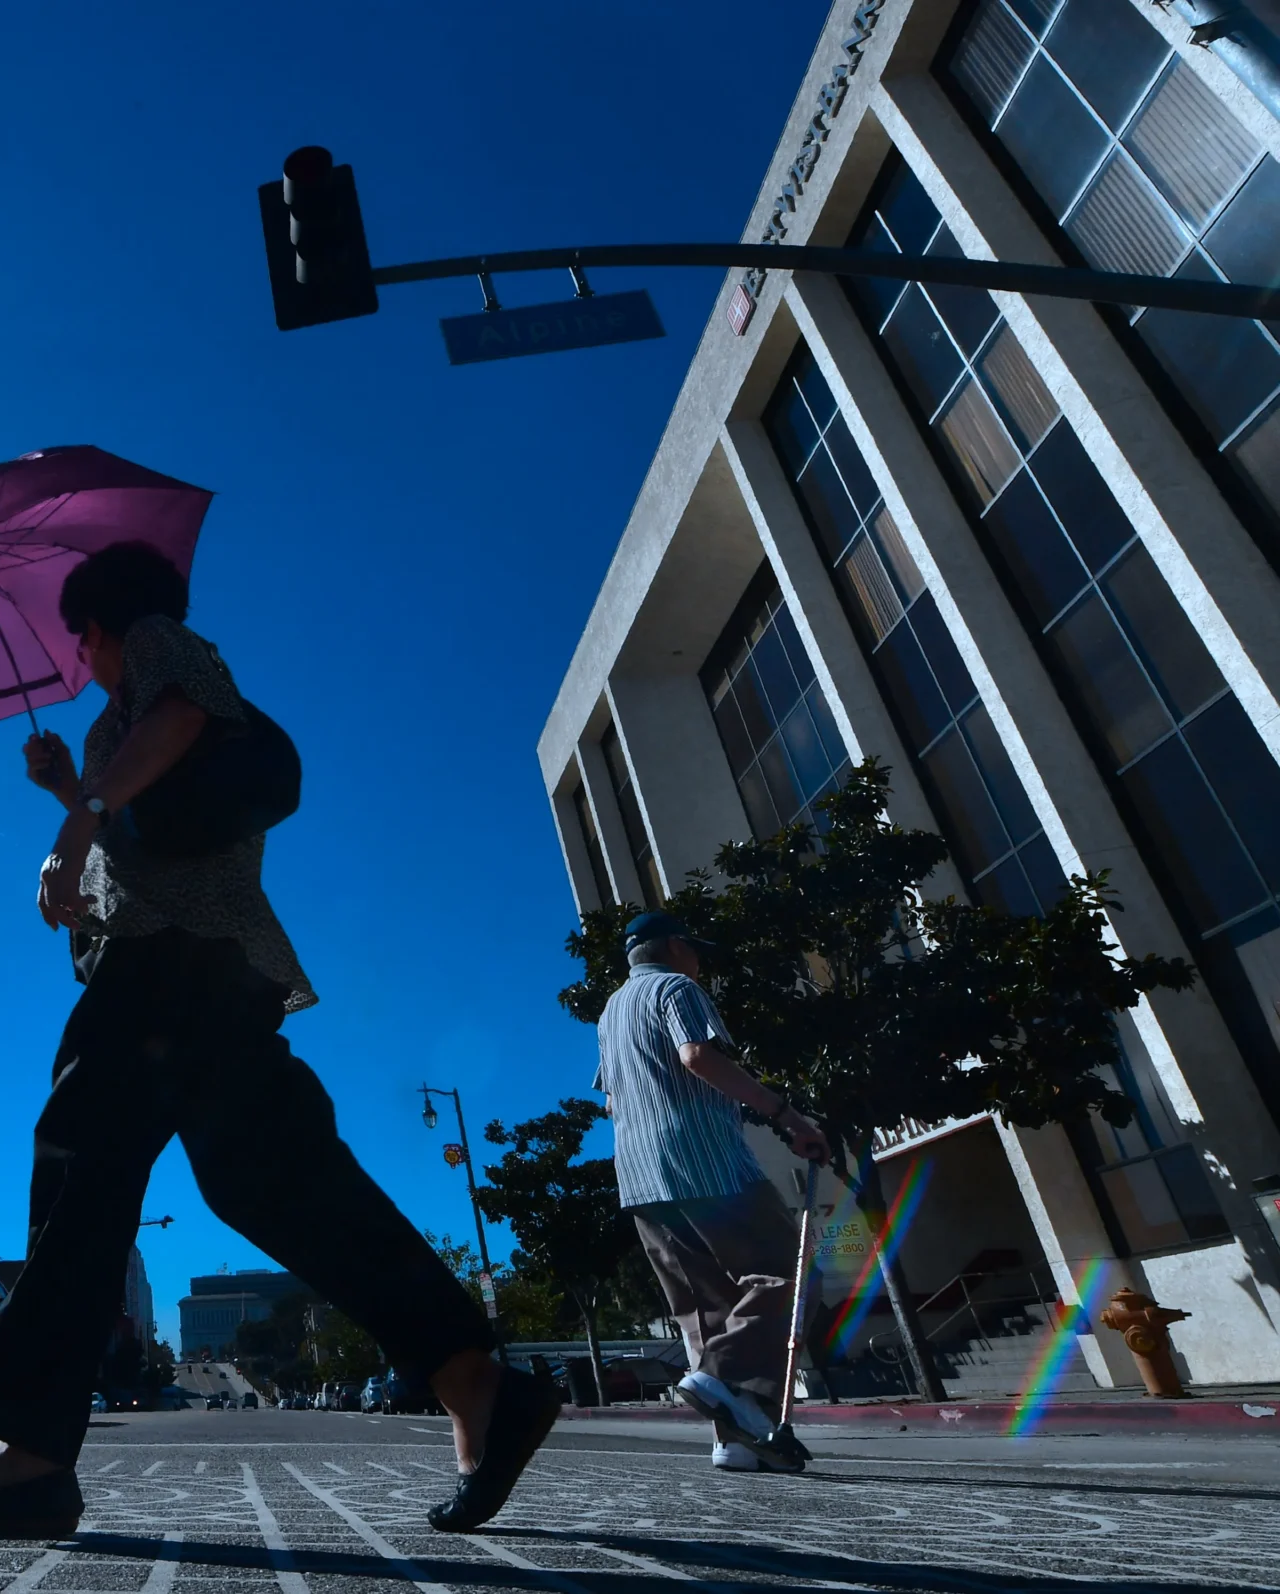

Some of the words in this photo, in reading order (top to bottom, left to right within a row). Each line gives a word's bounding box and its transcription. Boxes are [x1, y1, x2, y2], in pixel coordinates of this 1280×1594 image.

[774, 111, 831, 214] WEST
[477, 310, 627, 349] Alpine
[871, 1114, 947, 1154] ALPIN
[819, 1224, 861, 1240] LEASE
